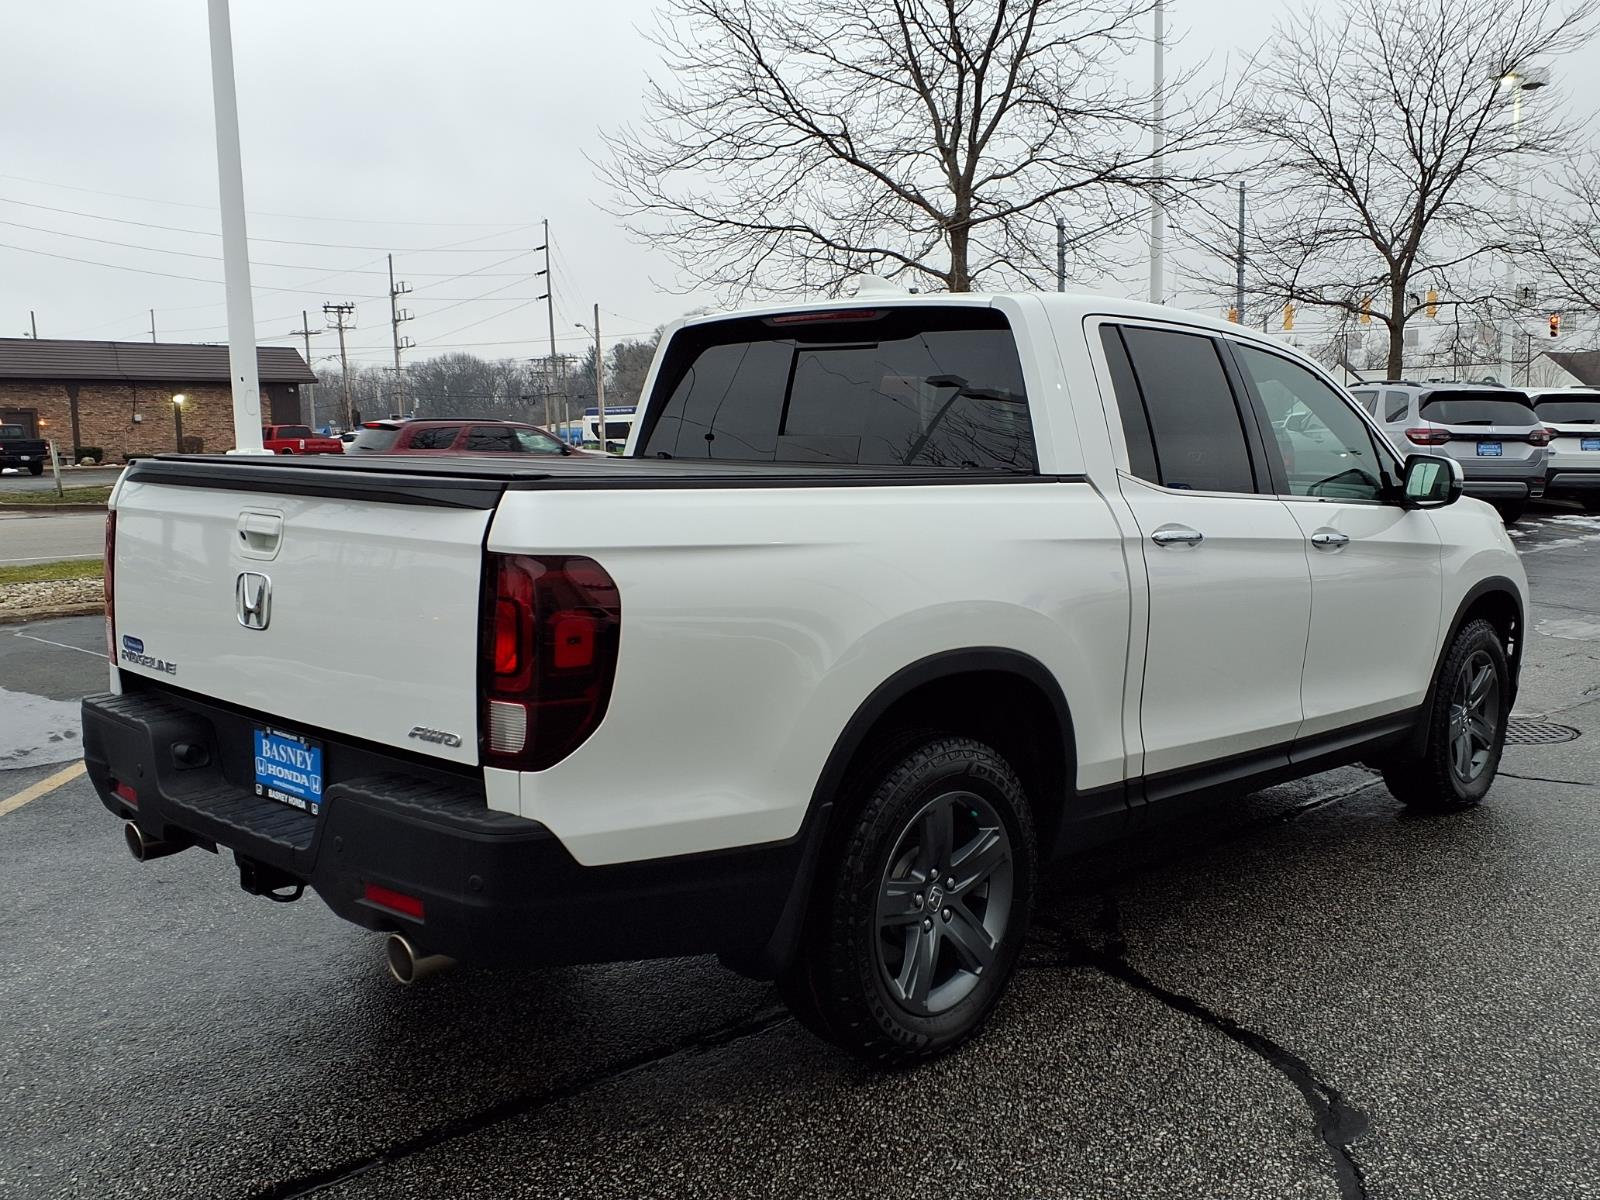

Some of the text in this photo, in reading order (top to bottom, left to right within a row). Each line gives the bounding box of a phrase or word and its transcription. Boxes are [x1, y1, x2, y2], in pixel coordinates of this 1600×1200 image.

[121, 648, 177, 675] RIDGELINE
[408, 725, 462, 748] AWD
[261, 738, 315, 771] BASNEY
[267, 763, 310, 787] HONDA
[268, 788, 307, 810] BASNEY HONDA
